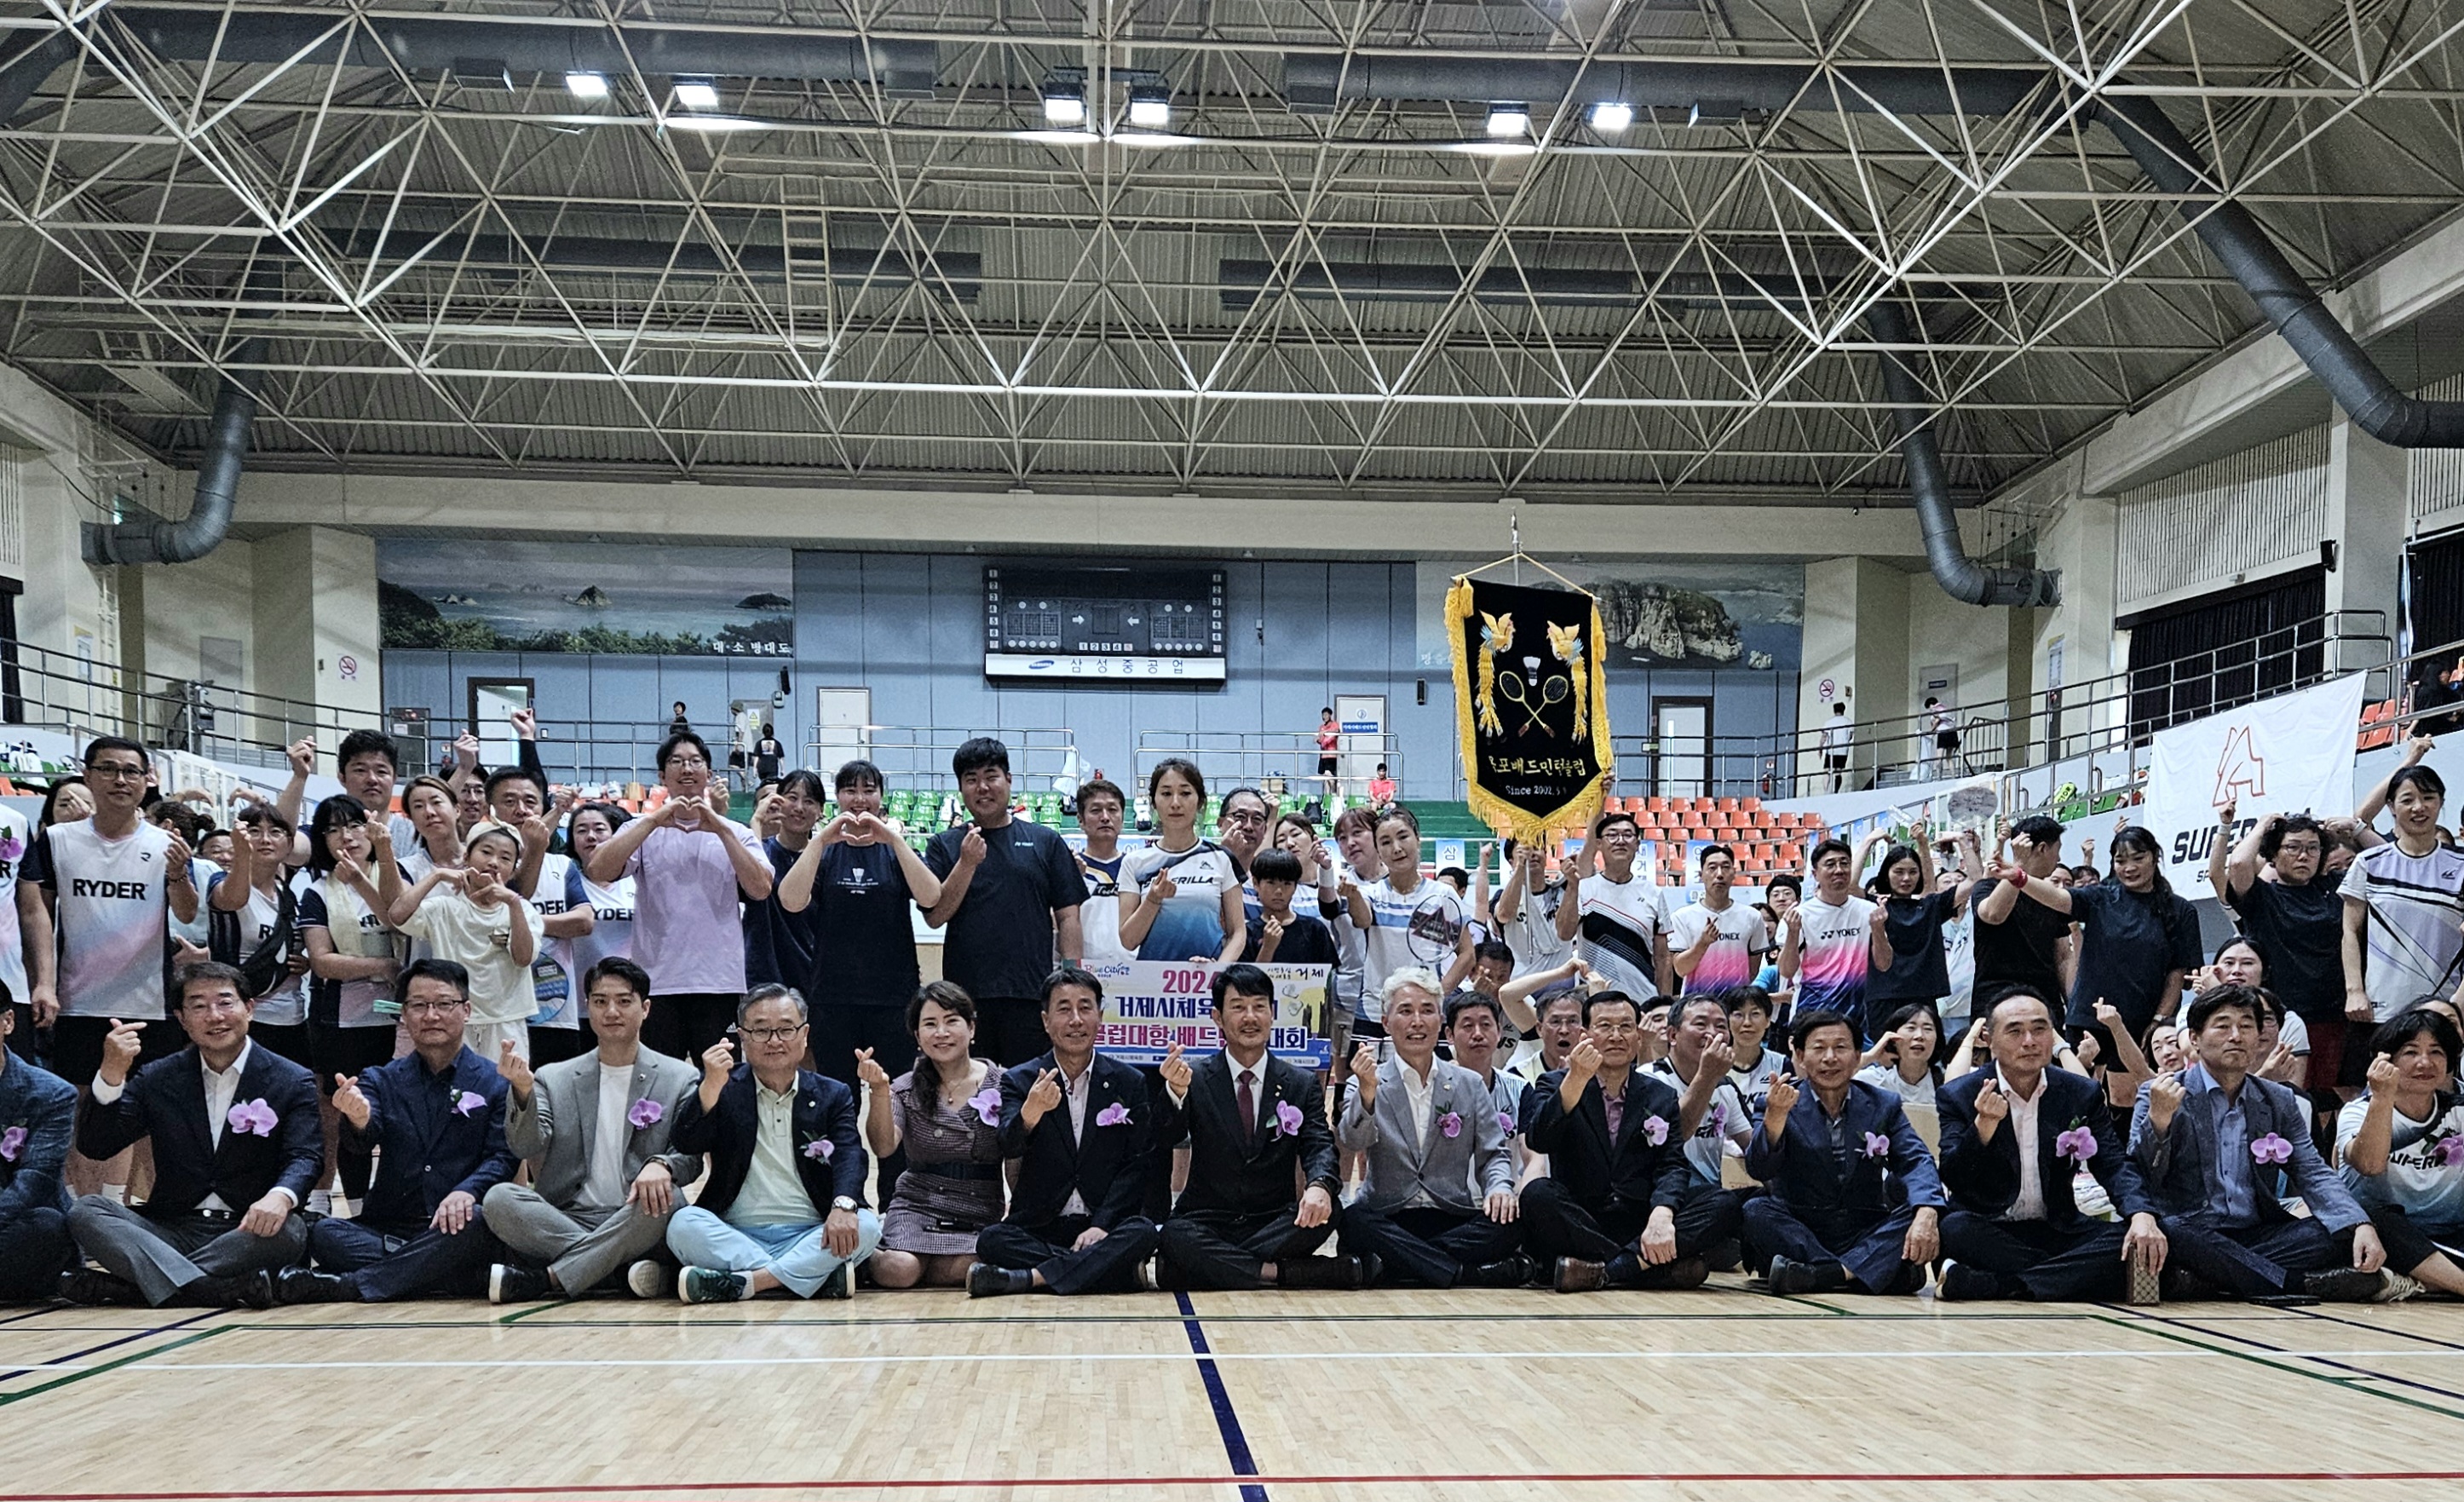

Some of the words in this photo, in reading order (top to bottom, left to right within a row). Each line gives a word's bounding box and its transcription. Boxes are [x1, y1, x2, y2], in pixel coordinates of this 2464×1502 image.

[750, 641, 791, 654] 병대도
[1070, 658, 1183, 675] 삼성중공업
[1505, 785, 1532, 796] Since
[72, 878, 147, 901] RYDER
[534, 900, 565, 915] DER
[1836, 927, 1861, 938] YONEX
[1295, 967, 1323, 980] 거제
